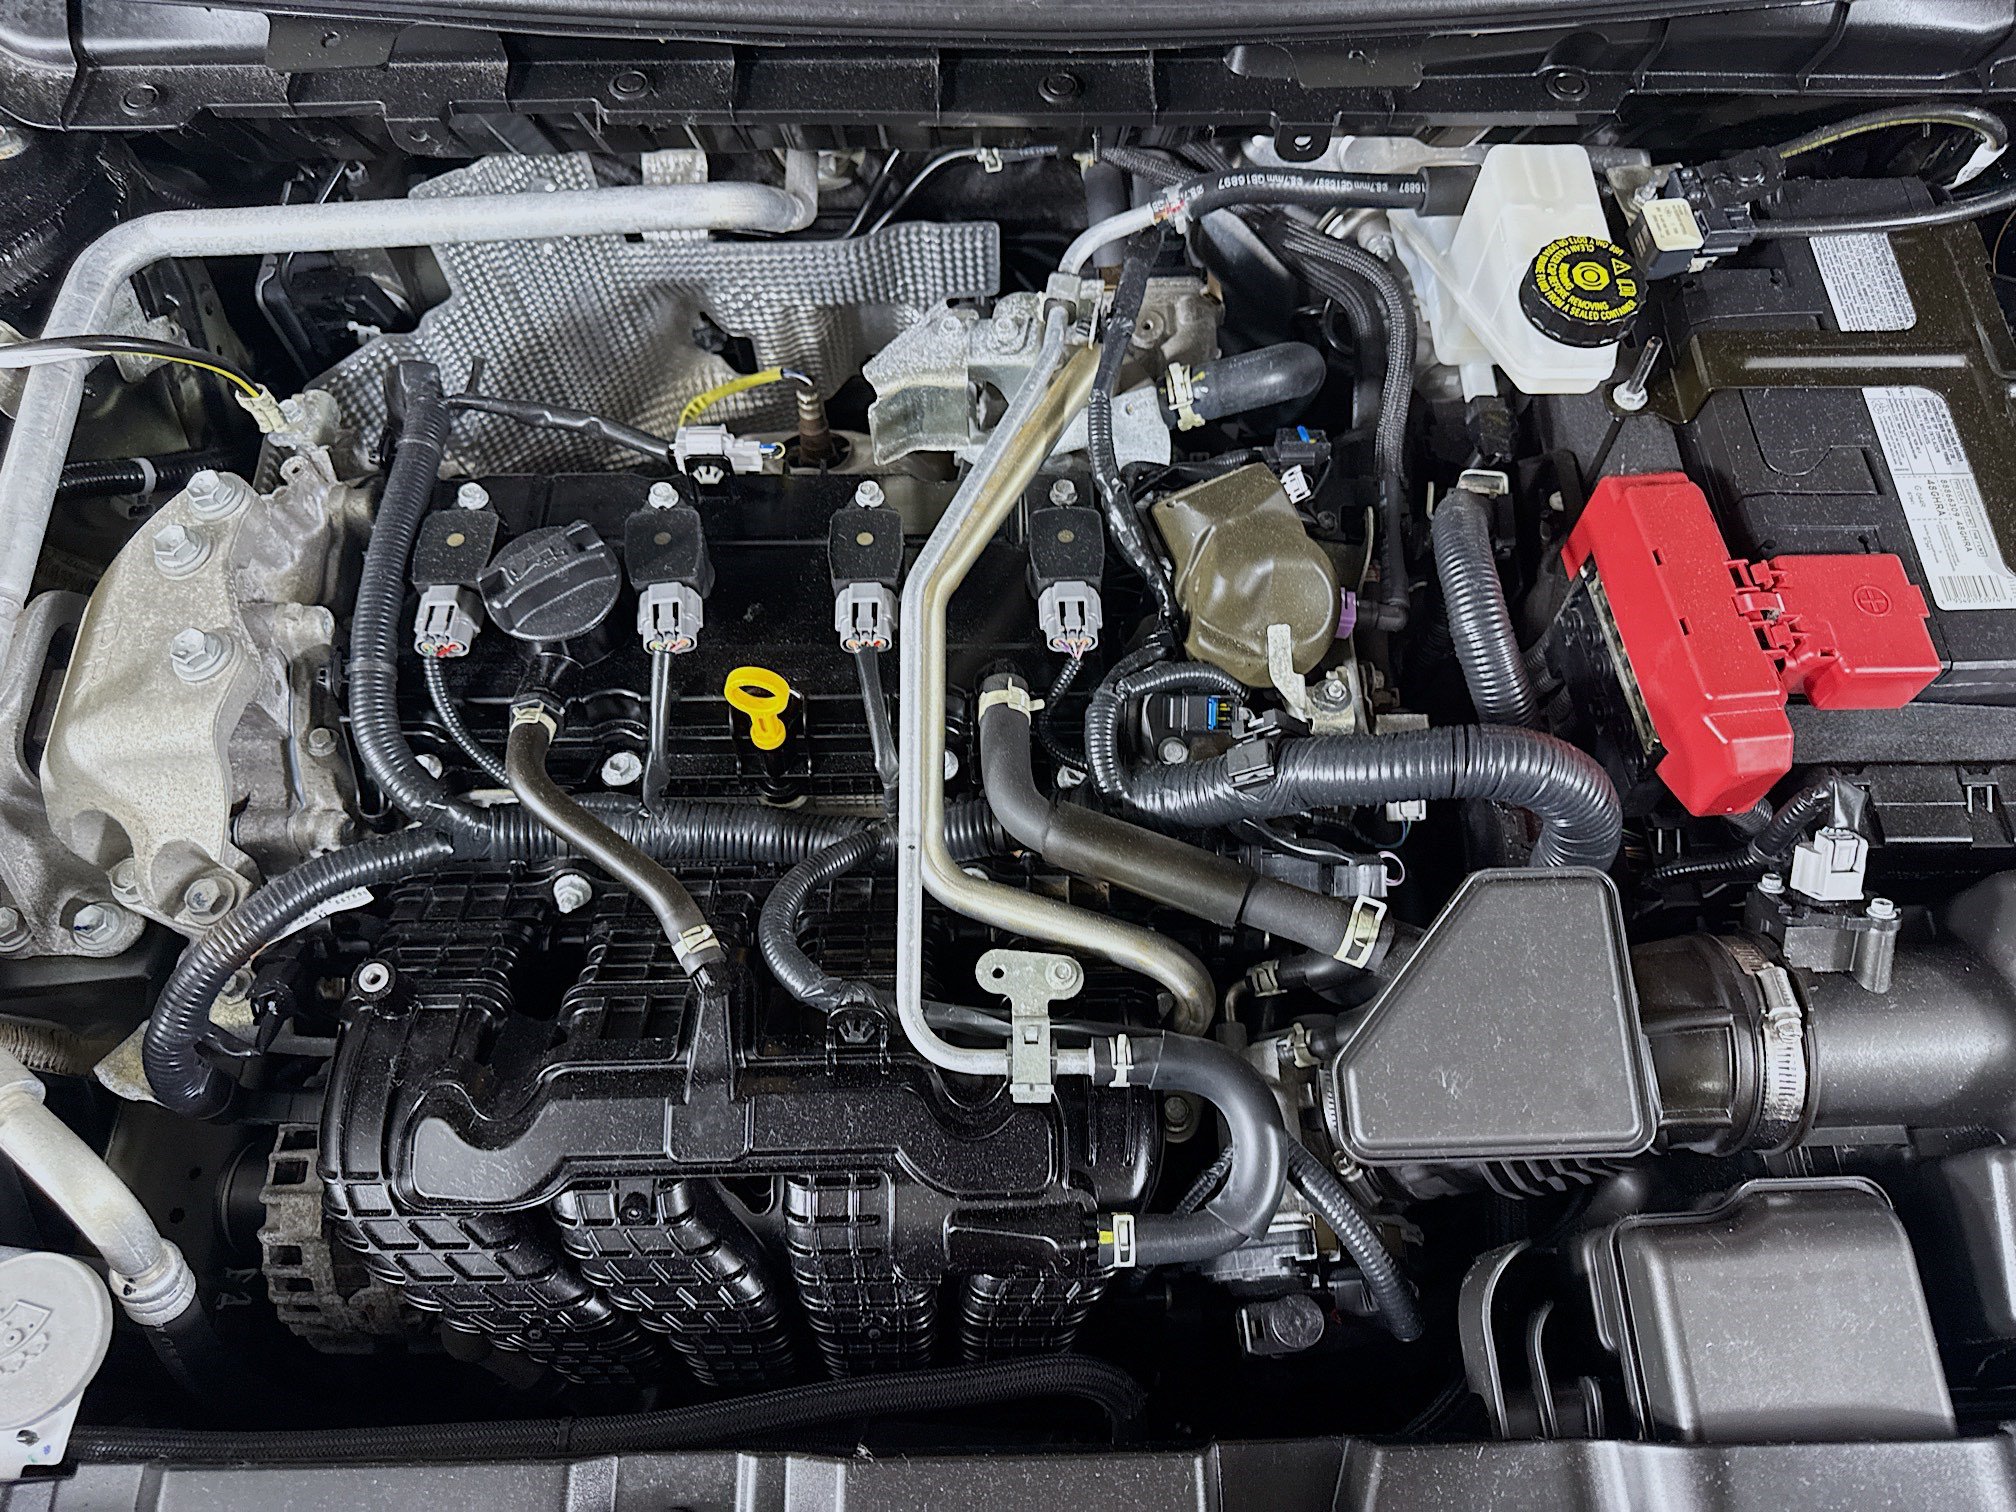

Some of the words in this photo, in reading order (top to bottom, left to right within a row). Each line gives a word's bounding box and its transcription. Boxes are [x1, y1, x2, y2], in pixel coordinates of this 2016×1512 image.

[1217, 173, 1266, 190] GB16897
[1399, 181, 1426, 194] 16897
[1569, 243, 1595, 253] CLEAN
[1608, 244, 1625, 257] USE
[1544, 291, 1565, 308] FROM
[1567, 295, 1610, 311] REMOVING
[1562, 303, 1570, 313] A
[1569, 306, 1599, 321] SEALED
[1600, 299, 1638, 321] CONTAINER
[1925, 479, 1947, 516] 48GHRA
[1939, 479, 1960, 517] 88866309
[1955, 520, 1974, 552] 48GHRA
